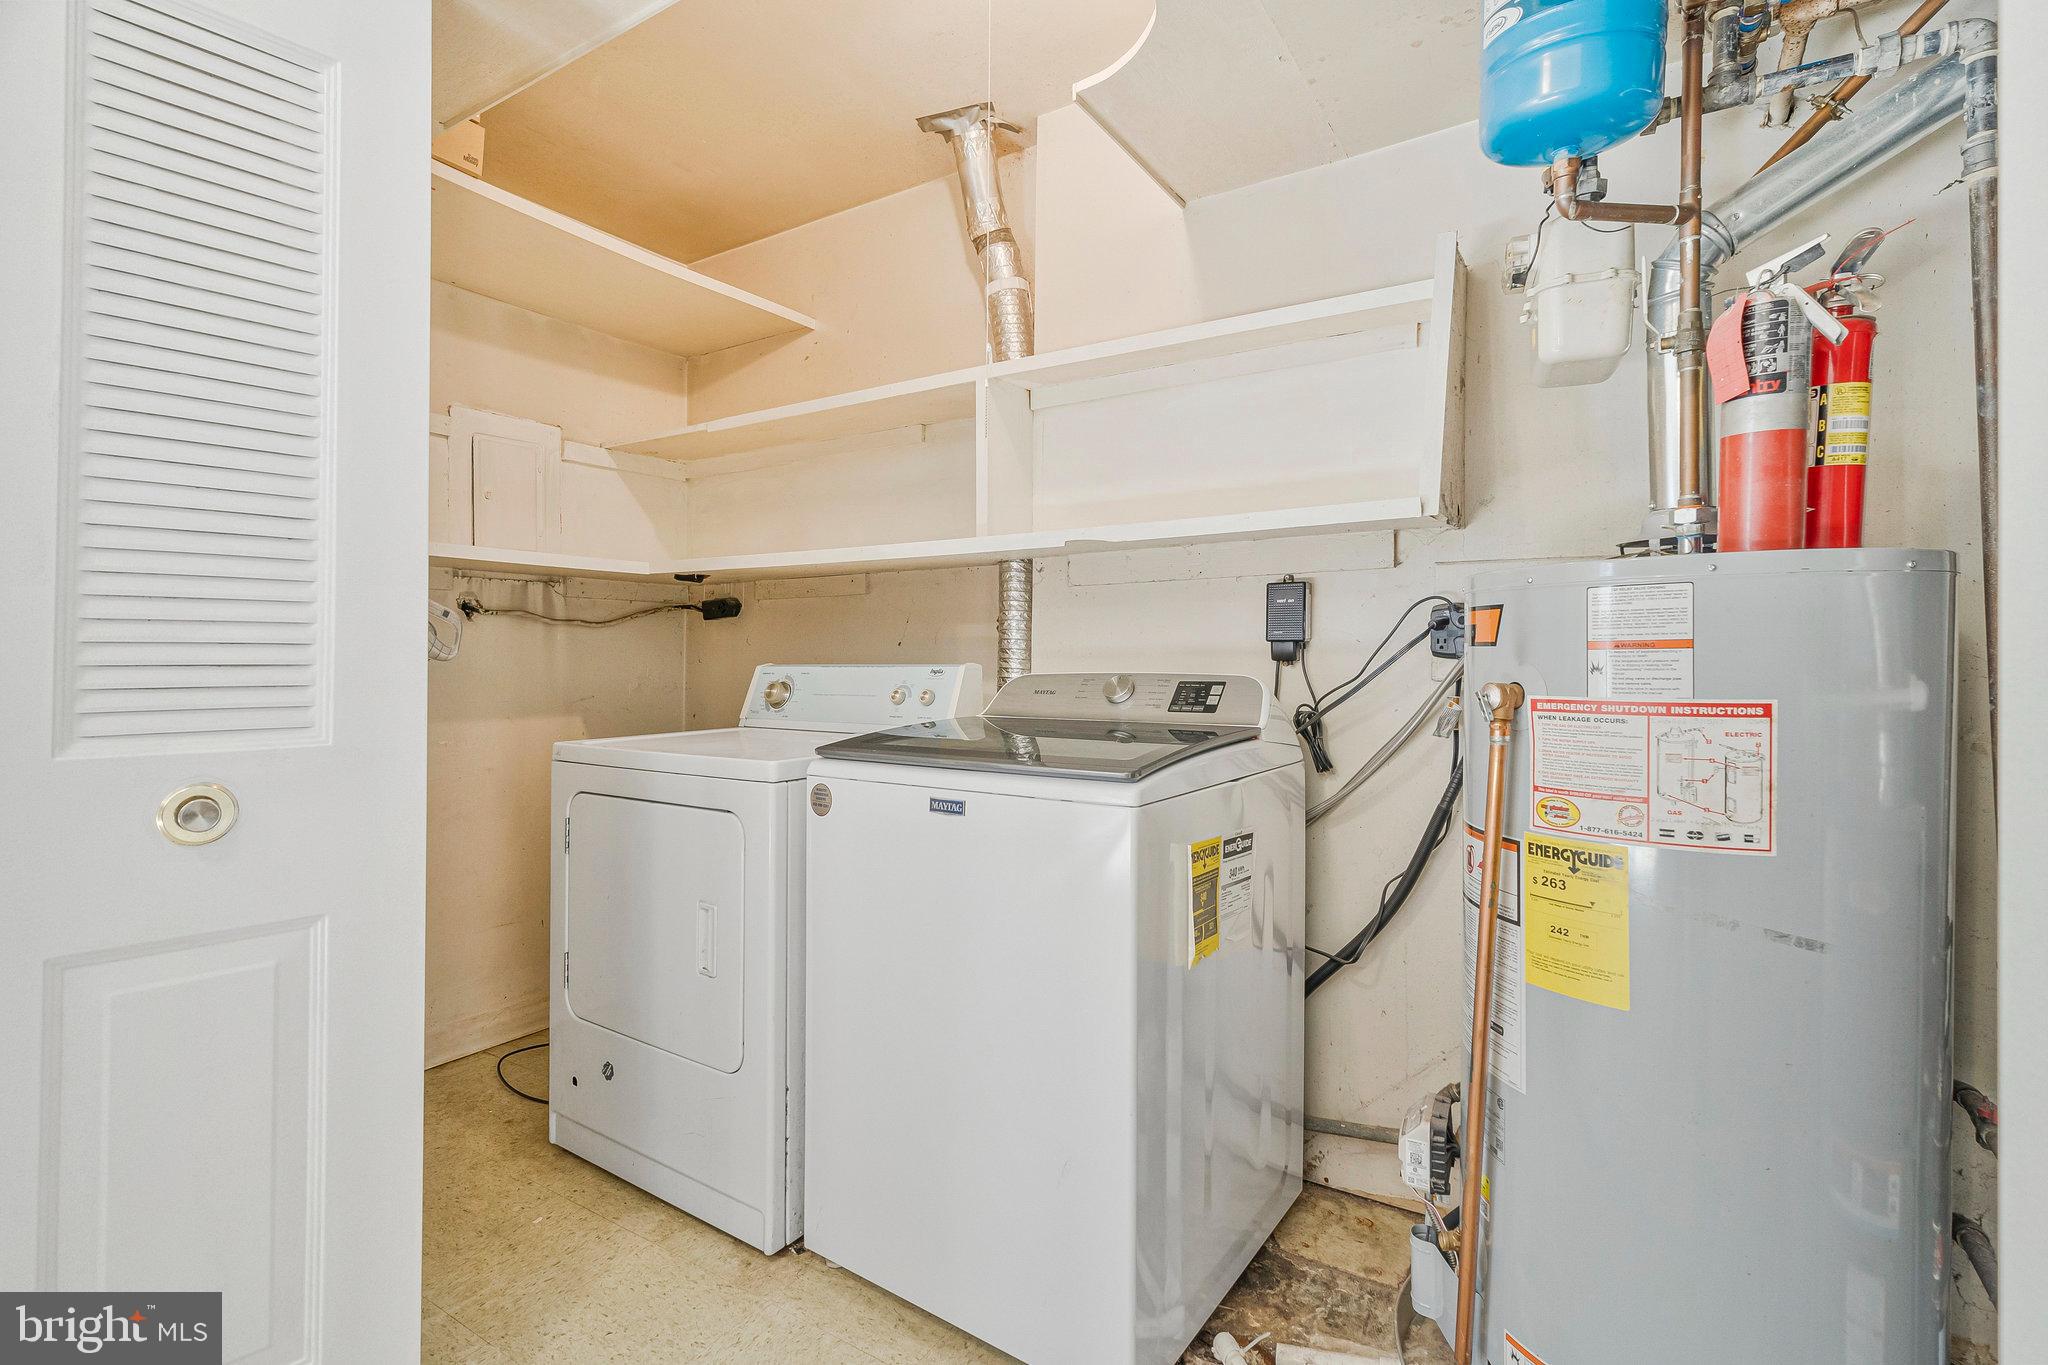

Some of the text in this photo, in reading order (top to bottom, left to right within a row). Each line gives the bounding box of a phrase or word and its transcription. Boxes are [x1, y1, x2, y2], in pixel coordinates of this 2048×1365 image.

[1819, 393, 1828, 406] A
[1818, 419, 1826, 432] B
[1816, 445, 1824, 458] C
[1536, 702, 1765, 716] EMERGENCY SHUTDOWN INSTRUCTIONS
[1558, 716, 1591, 724] LEAKAGE
[1593, 717, 1629, 725] OCCURS:
[931, 801, 963, 812] MAYTAG
[1580, 825, 1643, 837] 1-877-616-5424
[1527, 841, 1624, 870] ENERGYGUIDE
[1541, 875, 1566, 891] 263
[1550, 925, 1569, 937] 242
